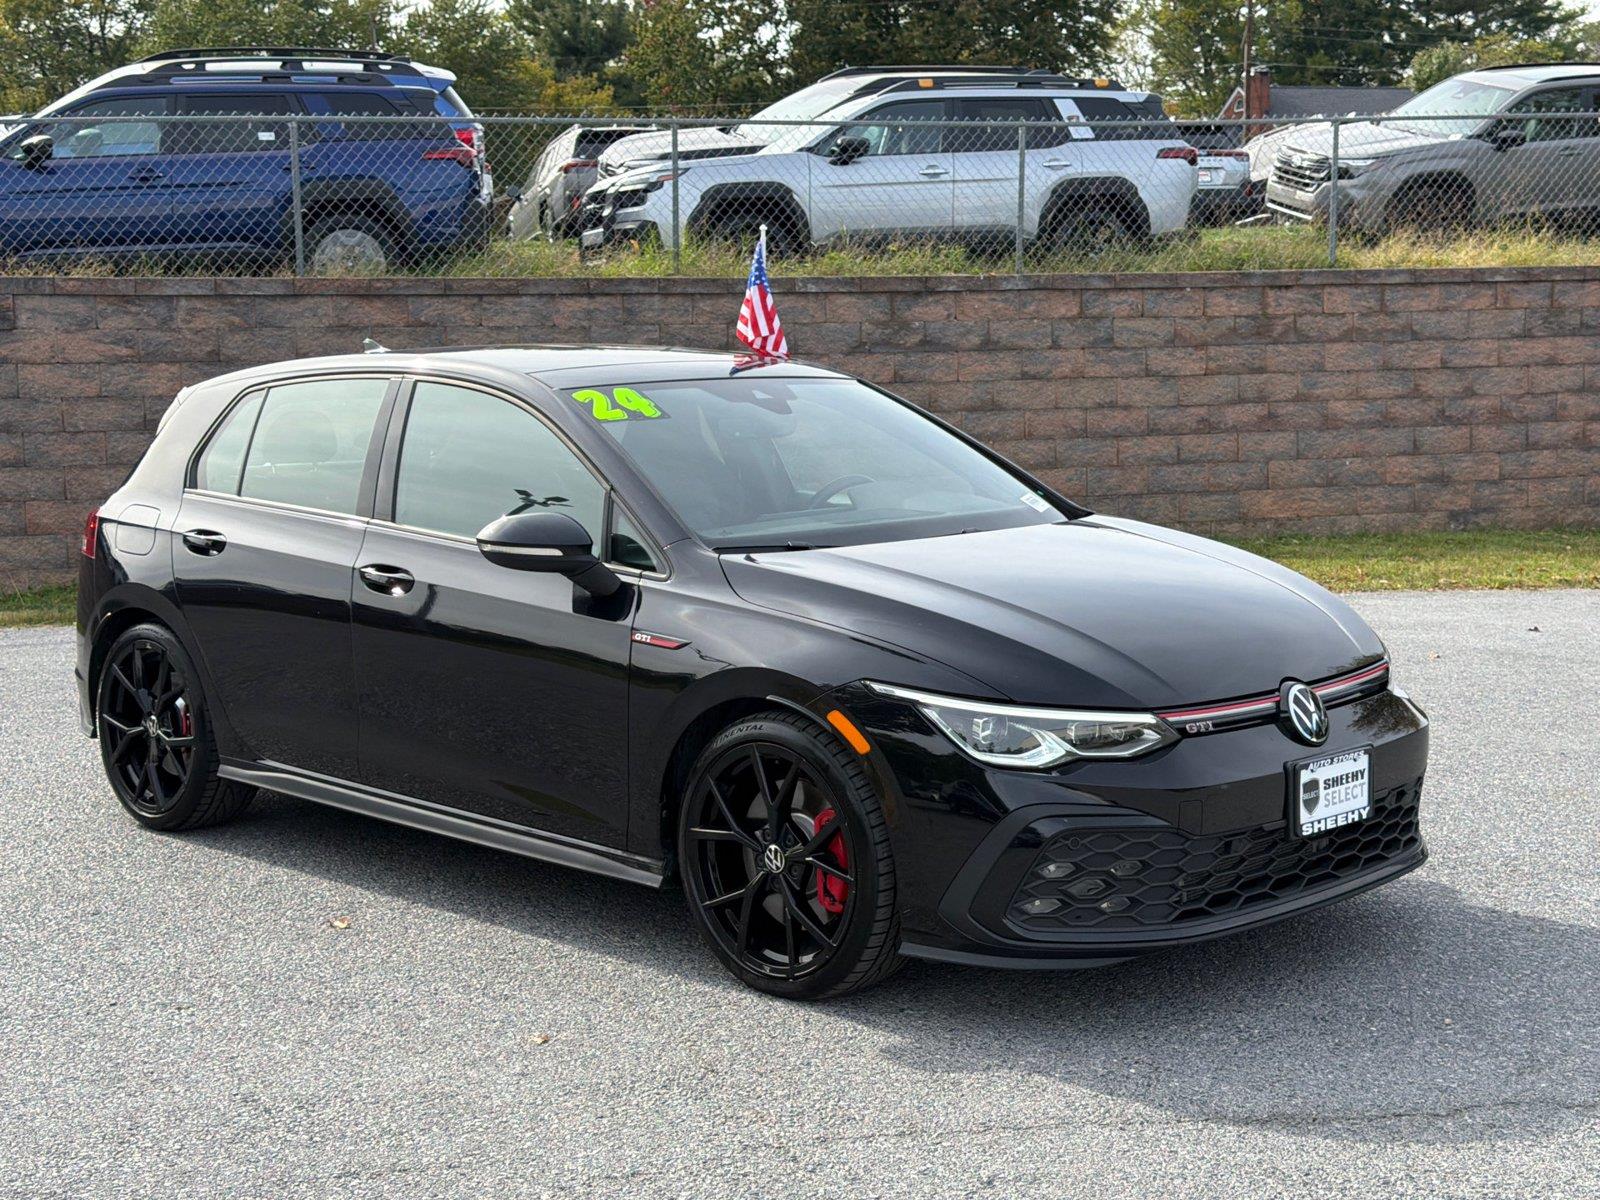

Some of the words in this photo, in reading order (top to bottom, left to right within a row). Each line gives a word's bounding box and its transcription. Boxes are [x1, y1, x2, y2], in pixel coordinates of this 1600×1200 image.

[571, 387, 661, 420] 24
[634, 633, 651, 643] GTI
[1185, 720, 1216, 734] GTI
[1307, 758, 1331, 771] AUTO
[1333, 750, 1365, 765] STORES
[1323, 768, 1366, 791] SHEEHY
[1324, 782, 1366, 808] SELECT
[1301, 806, 1370, 836] SHEEHY
